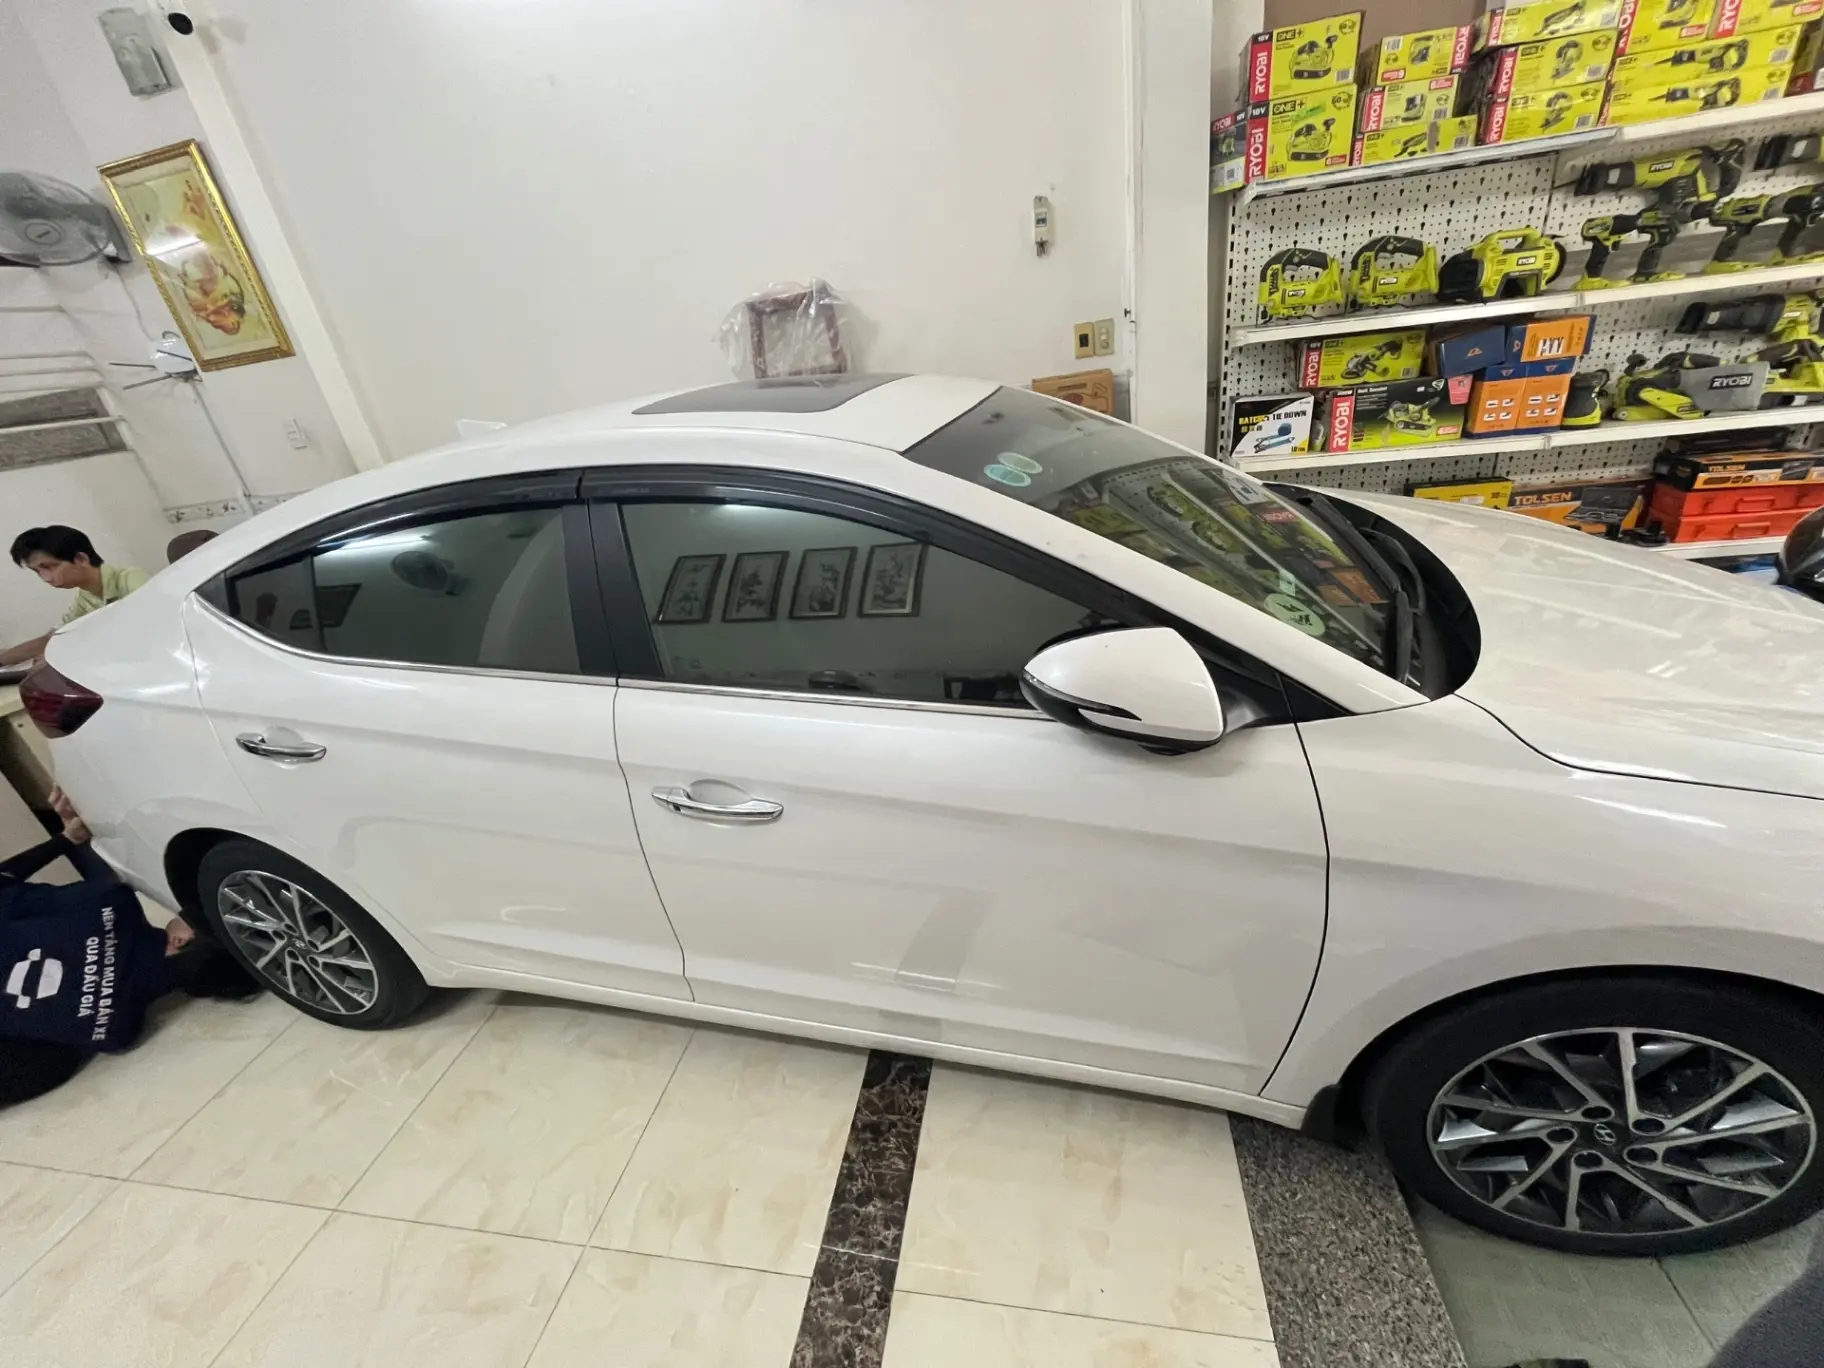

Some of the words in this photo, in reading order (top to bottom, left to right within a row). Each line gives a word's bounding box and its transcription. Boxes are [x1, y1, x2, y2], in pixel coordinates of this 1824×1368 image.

[1255, 51, 1268, 95] RYOBI
[1498, 57, 1514, 93] RYOBI
[1252, 107, 1266, 116] 18V
[1368, 94, 1381, 130] RYOBI
[1487, 106, 1505, 141] RYOBI
[1249, 128, 1264, 177] RYOBI
[1306, 351, 1319, 386] RYOBI
[1712, 375, 1752, 388] RYOBI
[1284, 410, 1307, 419] DOWN
[1333, 400, 1350, 448] RYOBI
[1513, 491, 1573, 506] TOLSEN
[85, 936, 99, 964] QUA
[101, 966, 115, 997] MUA
[77, 994, 95, 1018] GIÁ
[91, 1026, 107, 1041] XE
